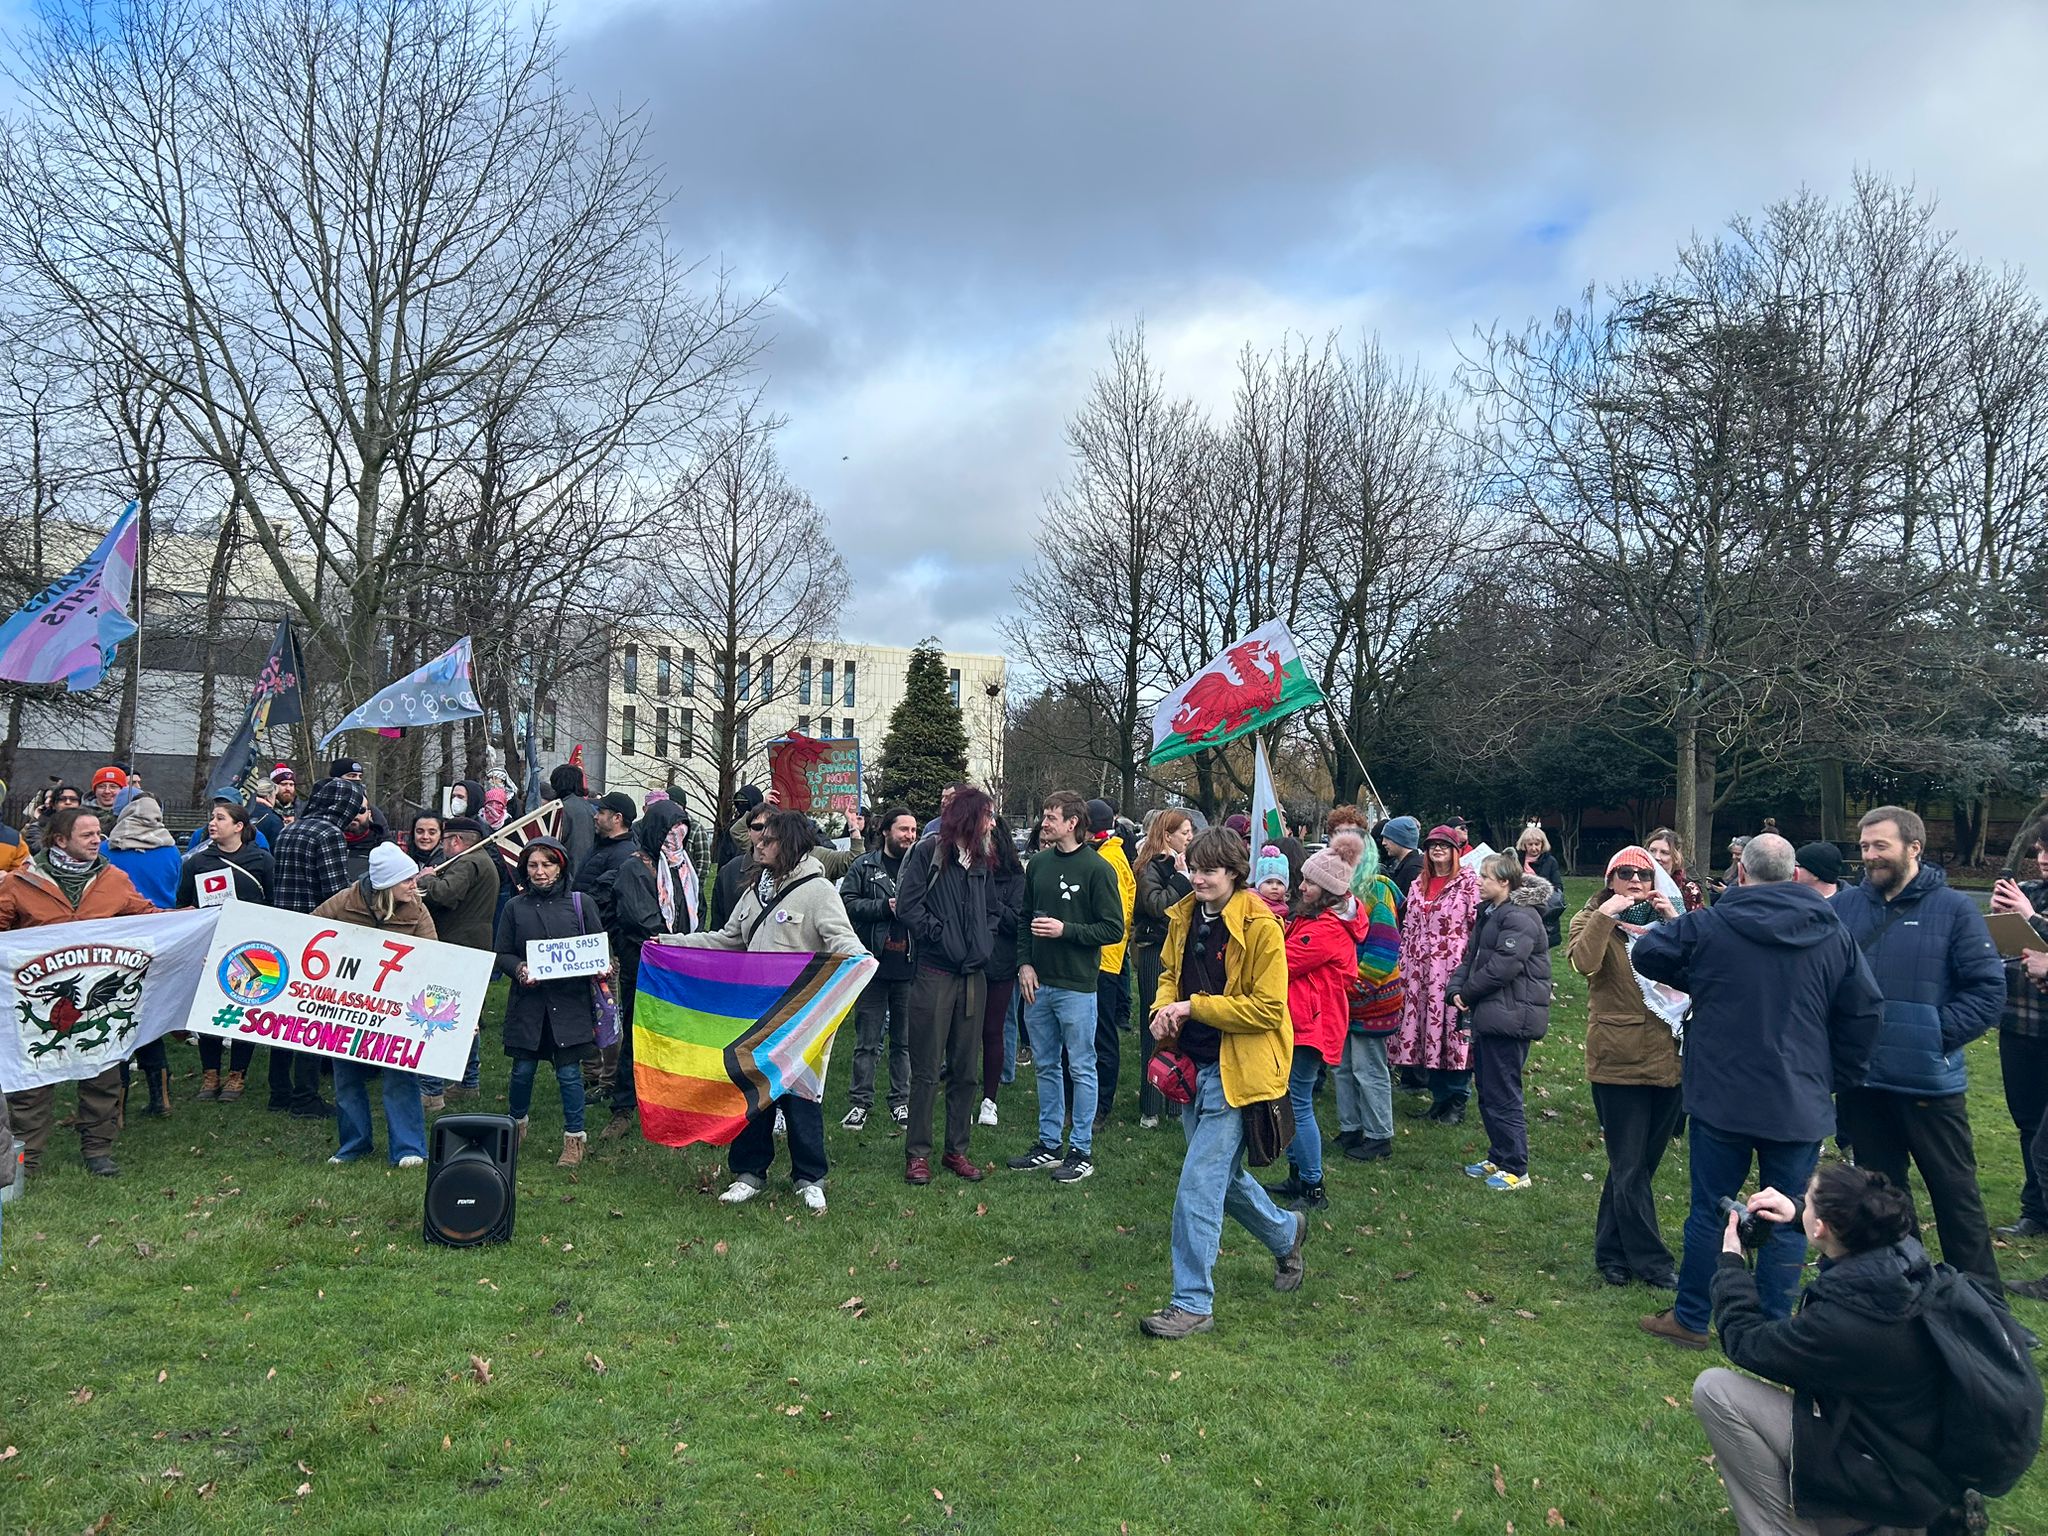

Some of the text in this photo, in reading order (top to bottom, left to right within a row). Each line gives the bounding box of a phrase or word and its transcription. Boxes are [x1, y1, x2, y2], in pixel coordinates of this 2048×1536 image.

[831, 750, 858, 762] OUR
[806, 771, 851, 785] IS NOT
[811, 784, 820, 795] A
[812, 795, 858, 809] OF HATE
[575, 937, 600, 949] SAYS
[300, 929, 415, 992] 6 IN 7
[551, 950, 576, 963] NO
[18, 965, 45, 985] O'R
[45, 949, 89, 973] AFON
[114, 950, 151, 969] MÔR
[537, 958, 606, 975] TO FASCISTS
[288, 980, 404, 1017] SEXUAL ASSAULTS
[297, 1000, 387, 1028] COMMITTED BY
